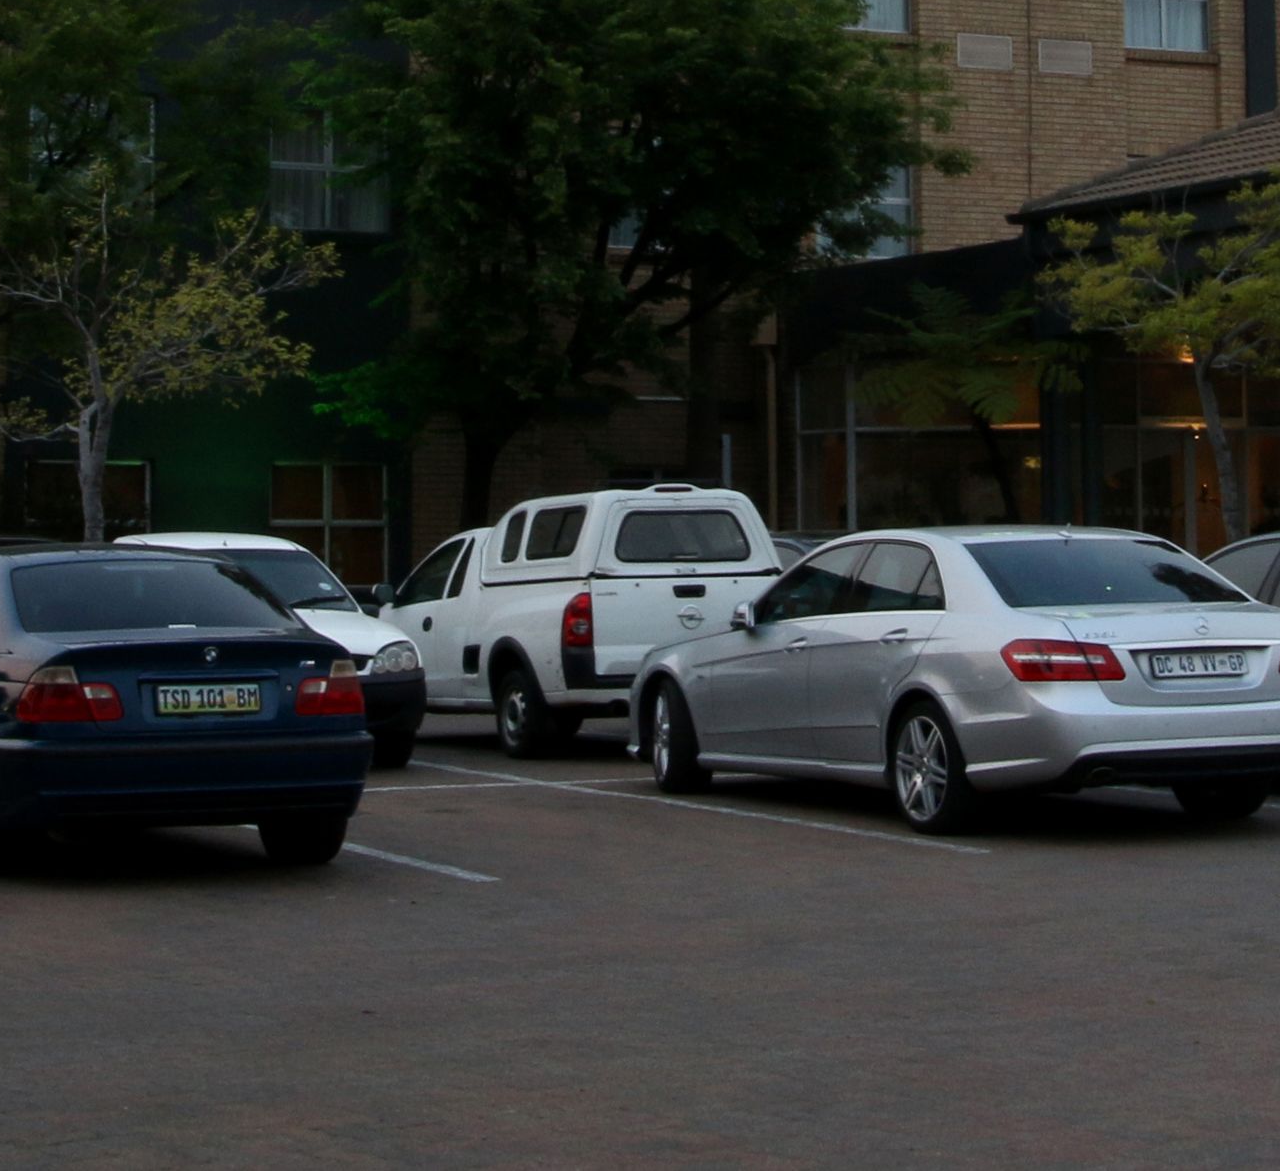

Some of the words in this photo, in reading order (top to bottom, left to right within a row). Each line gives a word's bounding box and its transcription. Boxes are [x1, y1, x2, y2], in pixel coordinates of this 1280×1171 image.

[1155, 656, 1174, 674] DC
[1179, 655, 1196, 673] 48
[1200, 654, 1217, 672] VV
[1228, 654, 1244, 671] GP
[160, 689, 191, 710] TSD
[196, 688, 227, 709] 101
[236, 688, 258, 708] BM
